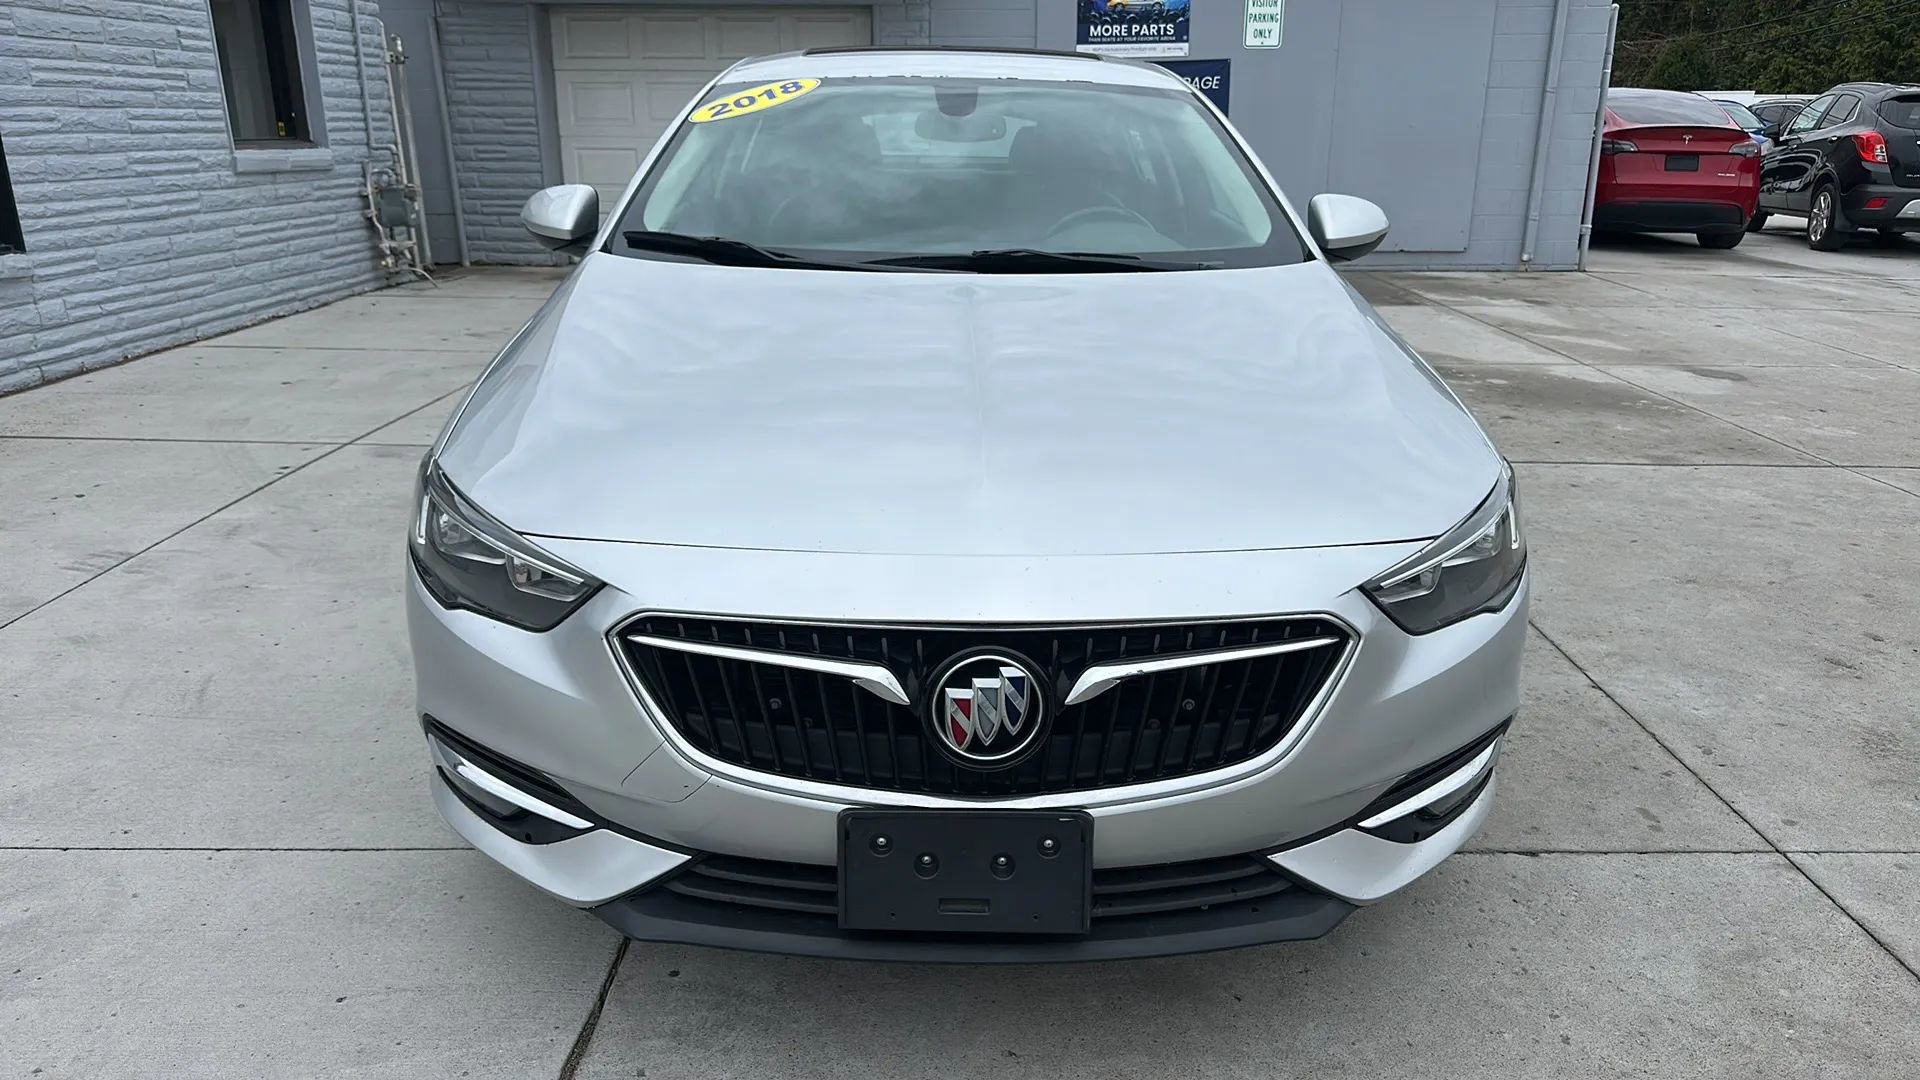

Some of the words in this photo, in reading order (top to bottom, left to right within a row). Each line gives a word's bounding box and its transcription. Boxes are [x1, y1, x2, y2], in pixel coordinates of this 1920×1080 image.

[1252, 0, 1279, 8] VISITOR
[1248, 13, 1279, 23] PARKING
[1089, 25, 1128, 37] MORE
[1131, 24, 1175, 36] PARTS
[1253, 28, 1273, 39] ONLY
[707, 81, 805, 118] 2018
